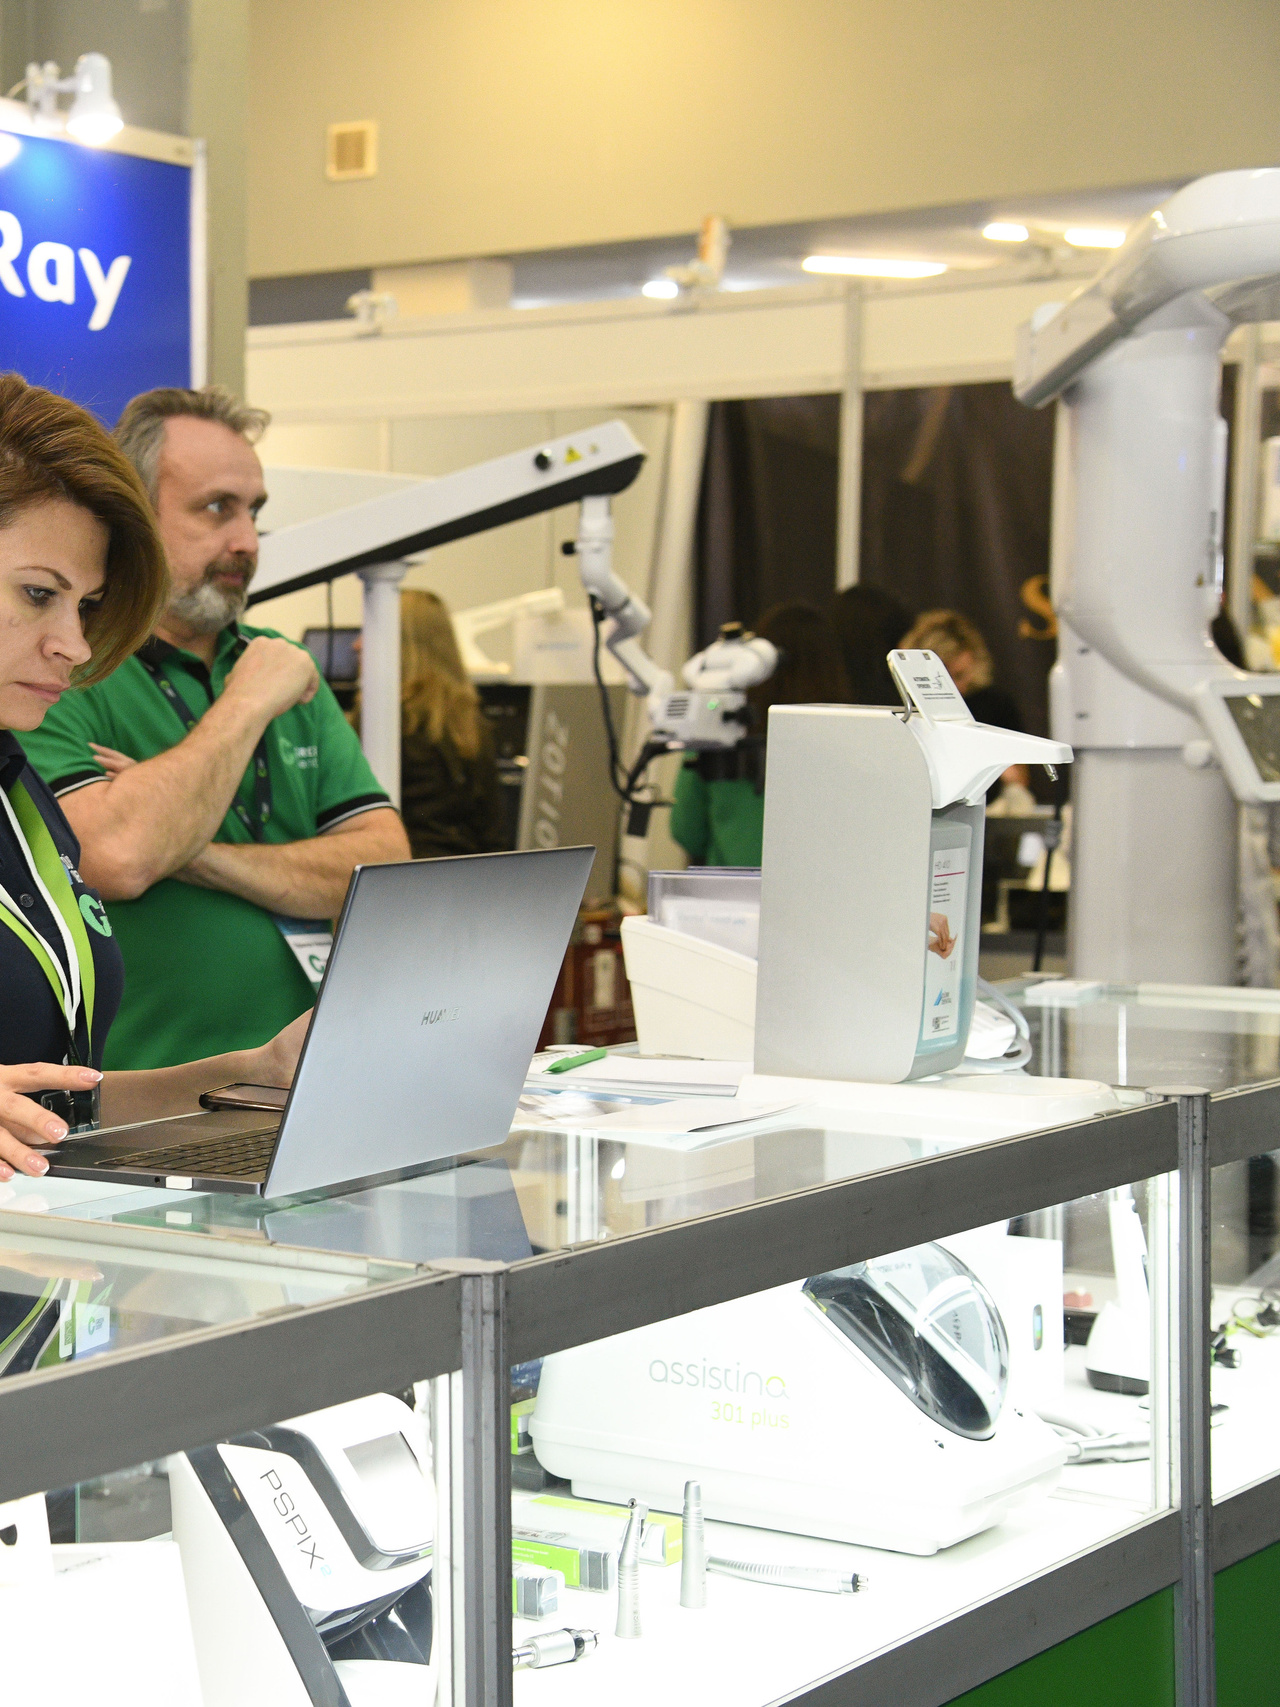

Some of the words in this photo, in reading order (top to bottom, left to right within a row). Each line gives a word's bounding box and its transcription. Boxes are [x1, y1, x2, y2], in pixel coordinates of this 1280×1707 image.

[648, 1357, 790, 1399] assistina
[710, 1401, 744, 1424] 301
[751, 1408, 790, 1431] plus
[260, 1469, 325, 1570] PSPIX
